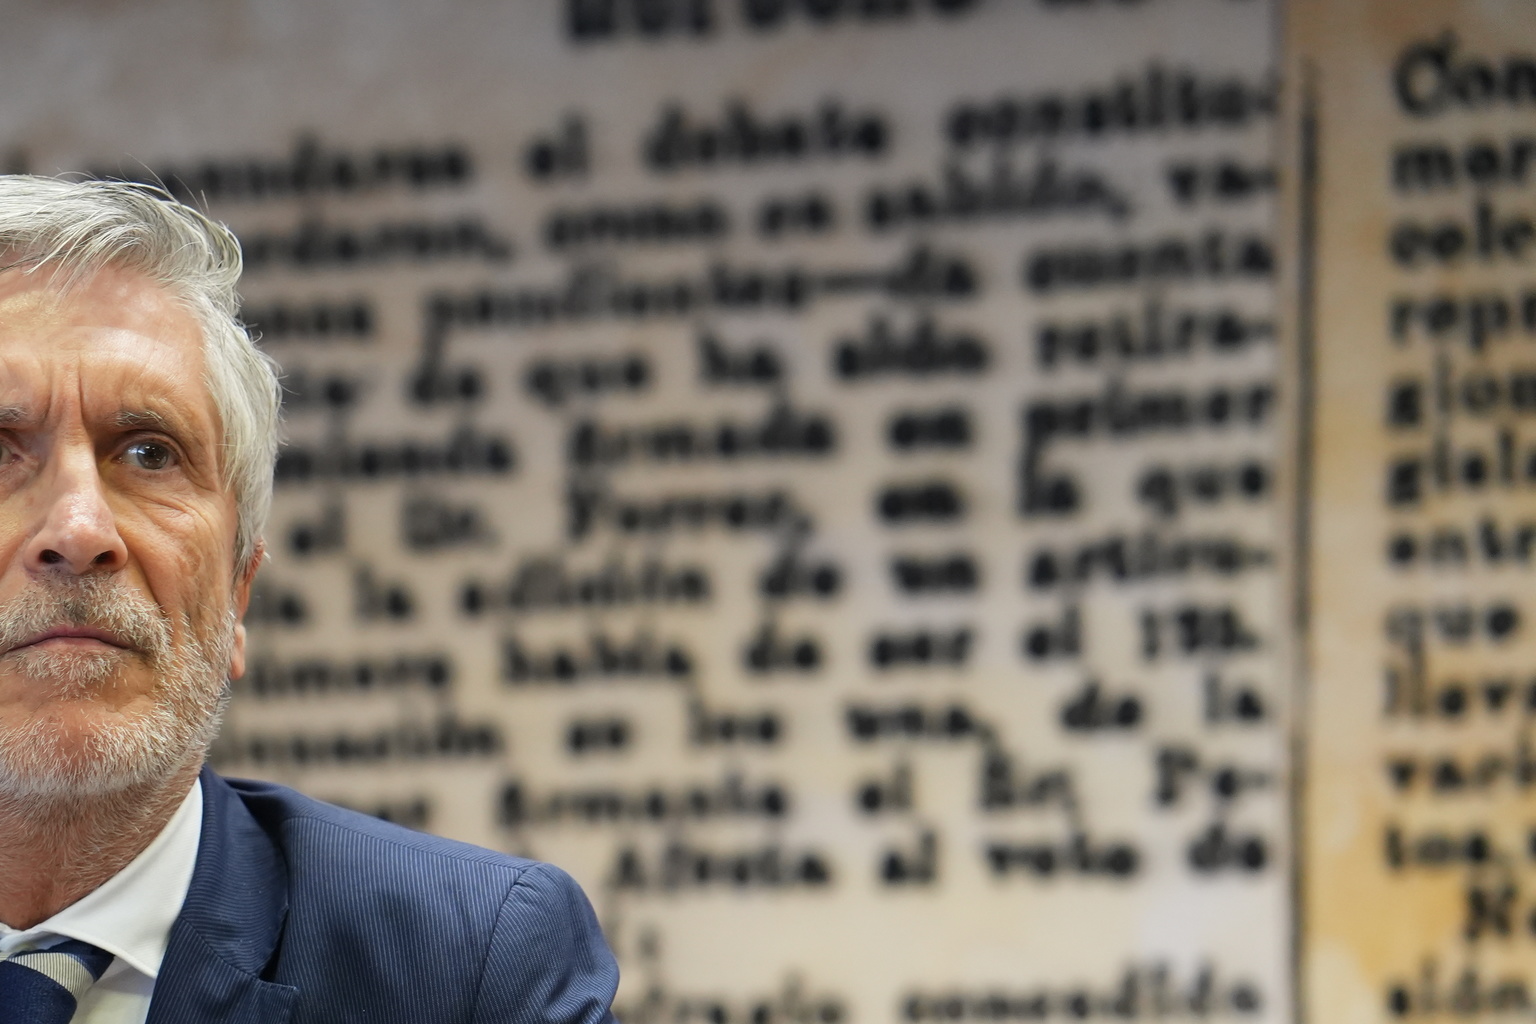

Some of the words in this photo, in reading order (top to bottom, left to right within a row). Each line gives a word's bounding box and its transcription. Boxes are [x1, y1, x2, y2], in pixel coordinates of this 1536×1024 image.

[644, 99, 892, 173] debate
[1024, 226, 1278, 296] cuenta
[522, 352, 652, 414] que
[698, 328, 786, 390] ha
[566, 393, 838, 476] firmada
[884, 403, 976, 458] en
[1020, 372, 1278, 468] primer
[874, 476, 972, 528] en
[1132, 453, 1276, 522] que
[758, 541, 846, 606] de
[738, 613, 828, 680] de
[1018, 597, 1088, 668] el
[1052, 670, 1152, 738] de
[1200, 665, 1274, 731] la
[850, 754, 918, 822] el
[978, 822, 1148, 890] voto
[1184, 810, 1274, 882] de
